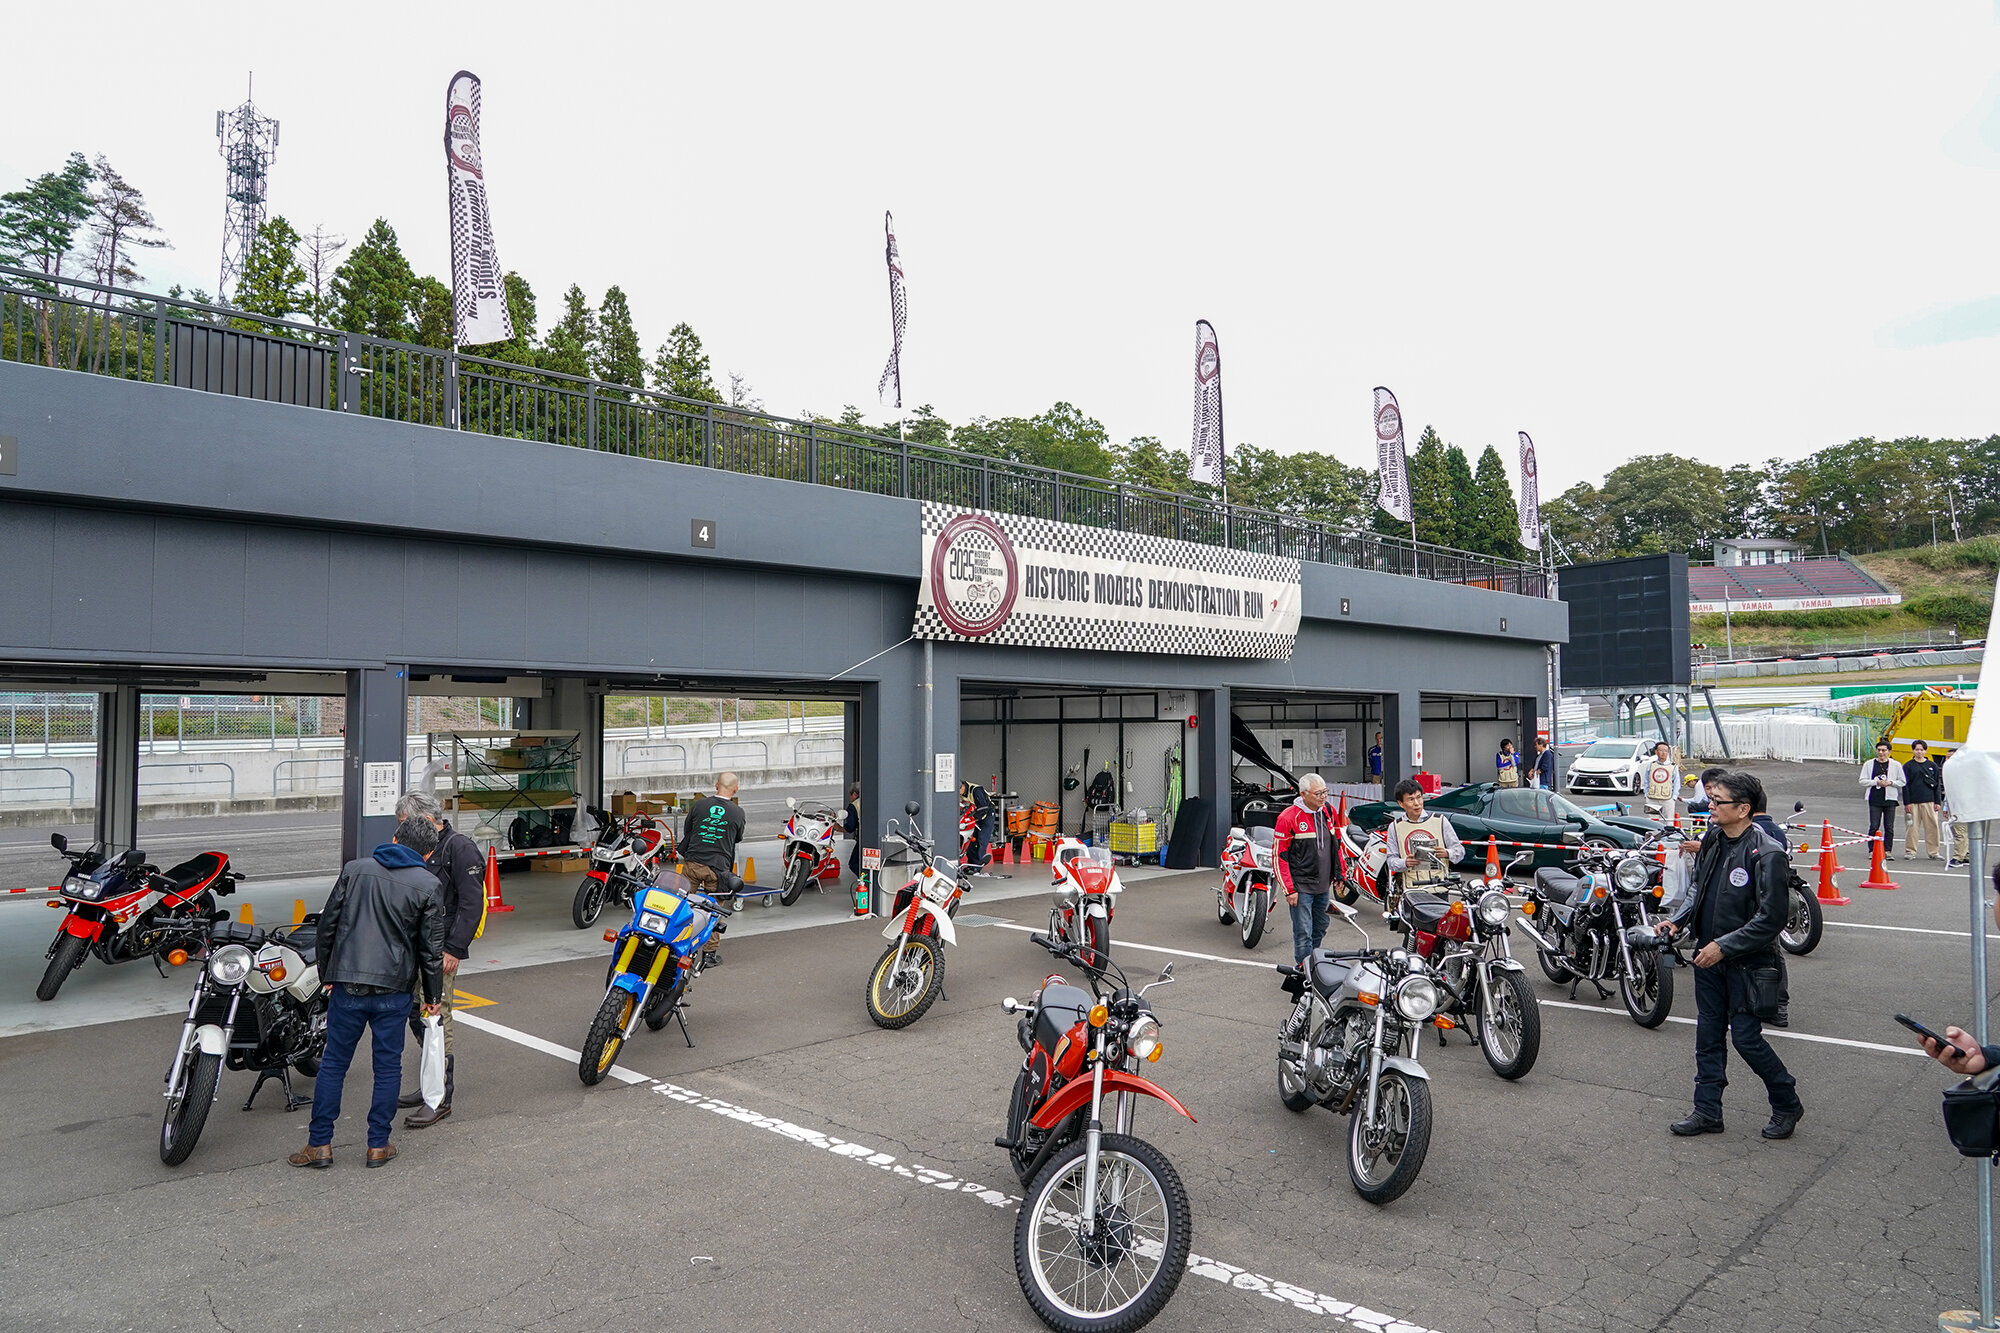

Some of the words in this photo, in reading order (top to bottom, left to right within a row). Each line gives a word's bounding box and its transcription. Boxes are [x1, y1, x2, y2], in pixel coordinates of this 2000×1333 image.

[699, 526, 709, 542] 4
[949, 547, 975, 581] 2025
[1025, 564, 1090, 603] HISTORIC
[1094, 573, 1143, 608] MODELS
[1148, 578, 1240, 617] DEMONSTRATION
[1244, 590, 1264, 619] RUN
[1741, 602, 1773, 610] YAMAHA
[1800, 600, 1833, 608] YAMAHA
[1860, 597, 1892, 606] YAMAHA
[1689, 604, 1714, 612] AMAHA
